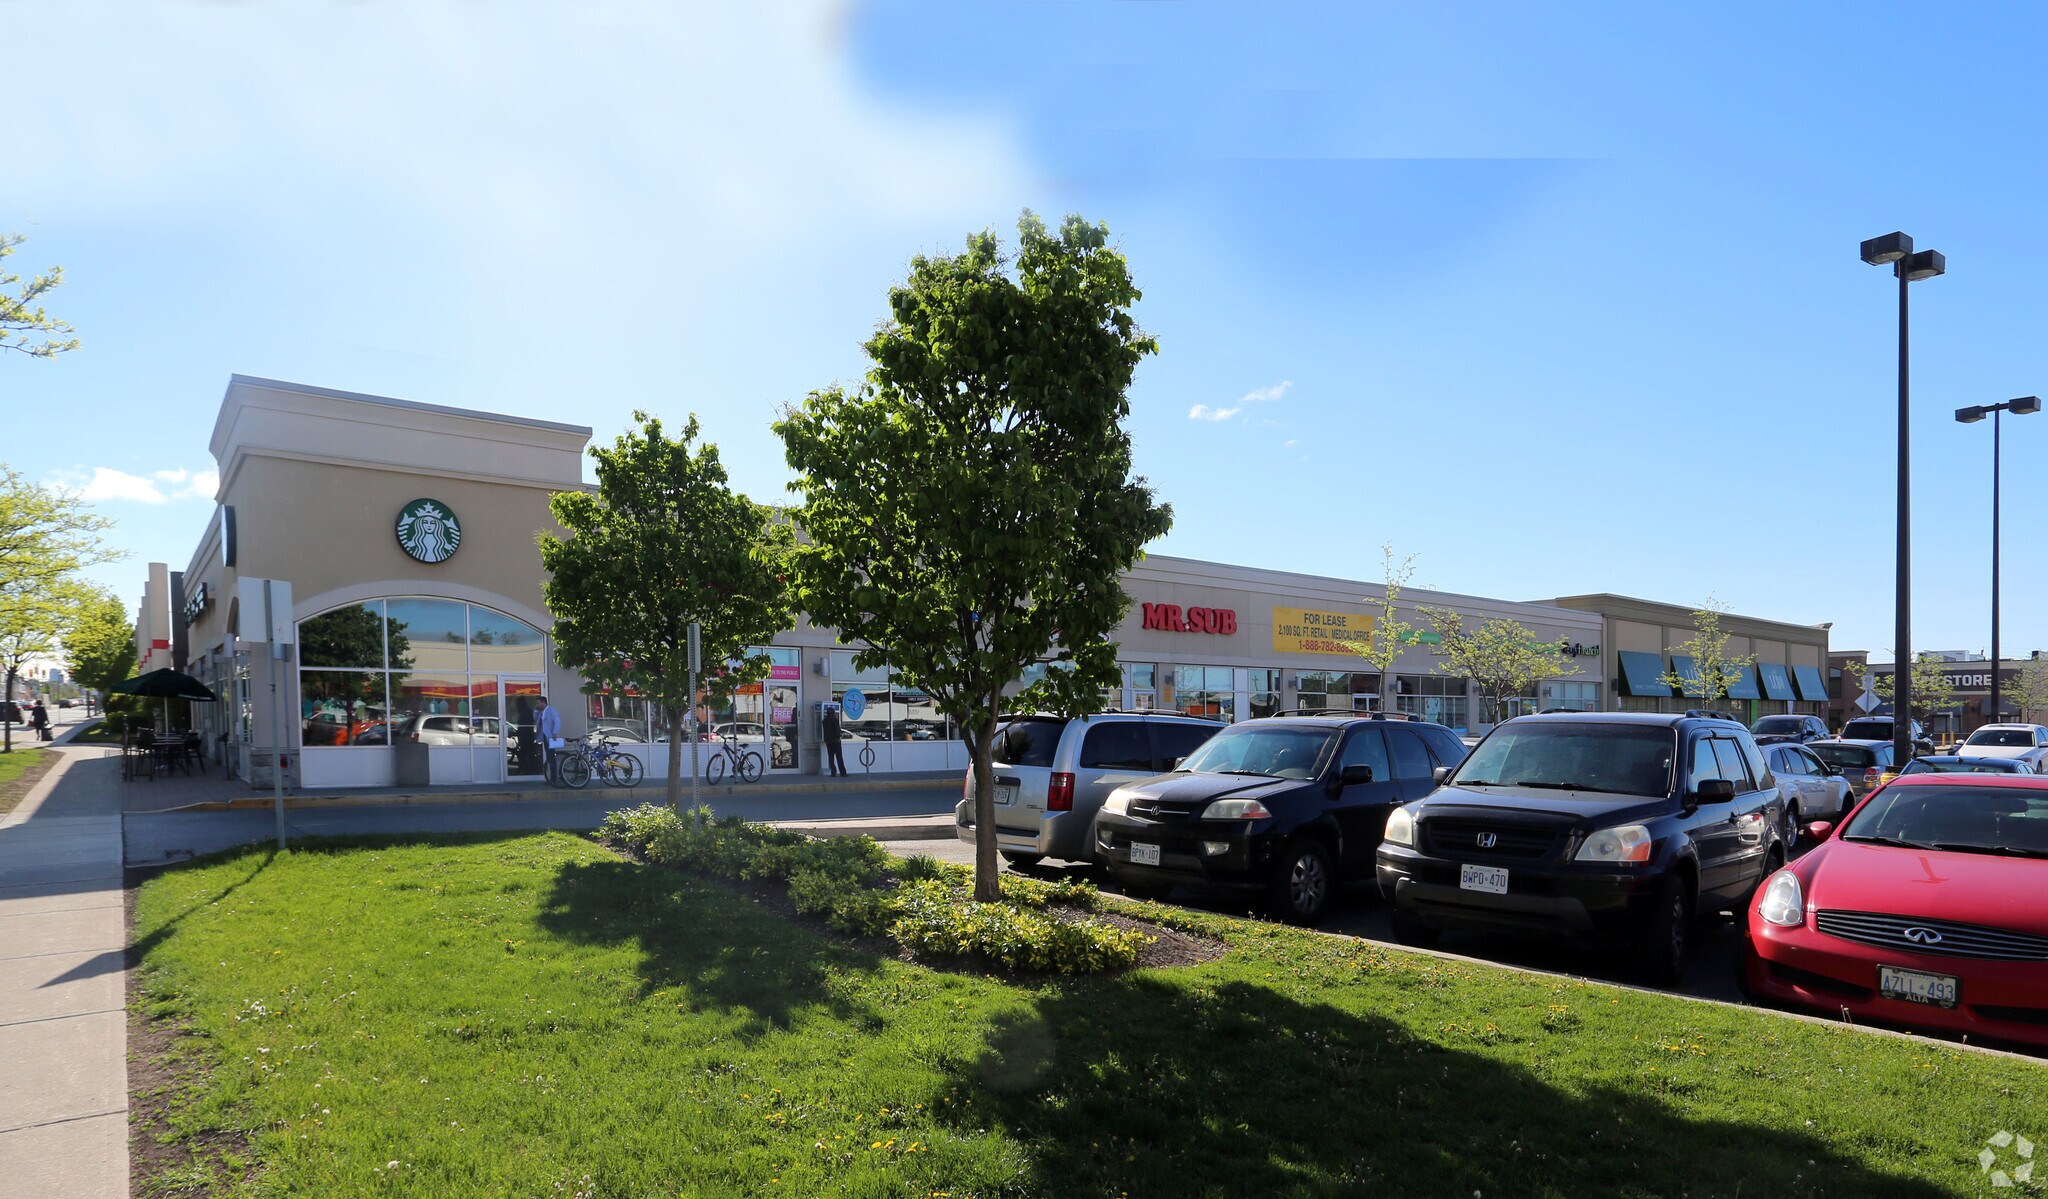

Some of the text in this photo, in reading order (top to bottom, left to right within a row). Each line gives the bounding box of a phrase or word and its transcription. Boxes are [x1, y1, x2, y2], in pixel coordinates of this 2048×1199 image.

[1304, 613, 1346, 627] FOR LEASE
[1279, 624, 1293, 637] 2,100
[1293, 626, 1302, 637] SQ.
[1311, 627, 1328, 639] RETAIL
[1331, 629, 1352, 640] MEDICAL
[1353, 630, 1370, 642] OFFICE
[1944, 674, 1992, 687] STORE
[1463, 871, 1506, 887] BWPD 470
[1884, 976, 1953, 1001] AZLL 493
[1905, 994, 1928, 1003] ALTA
